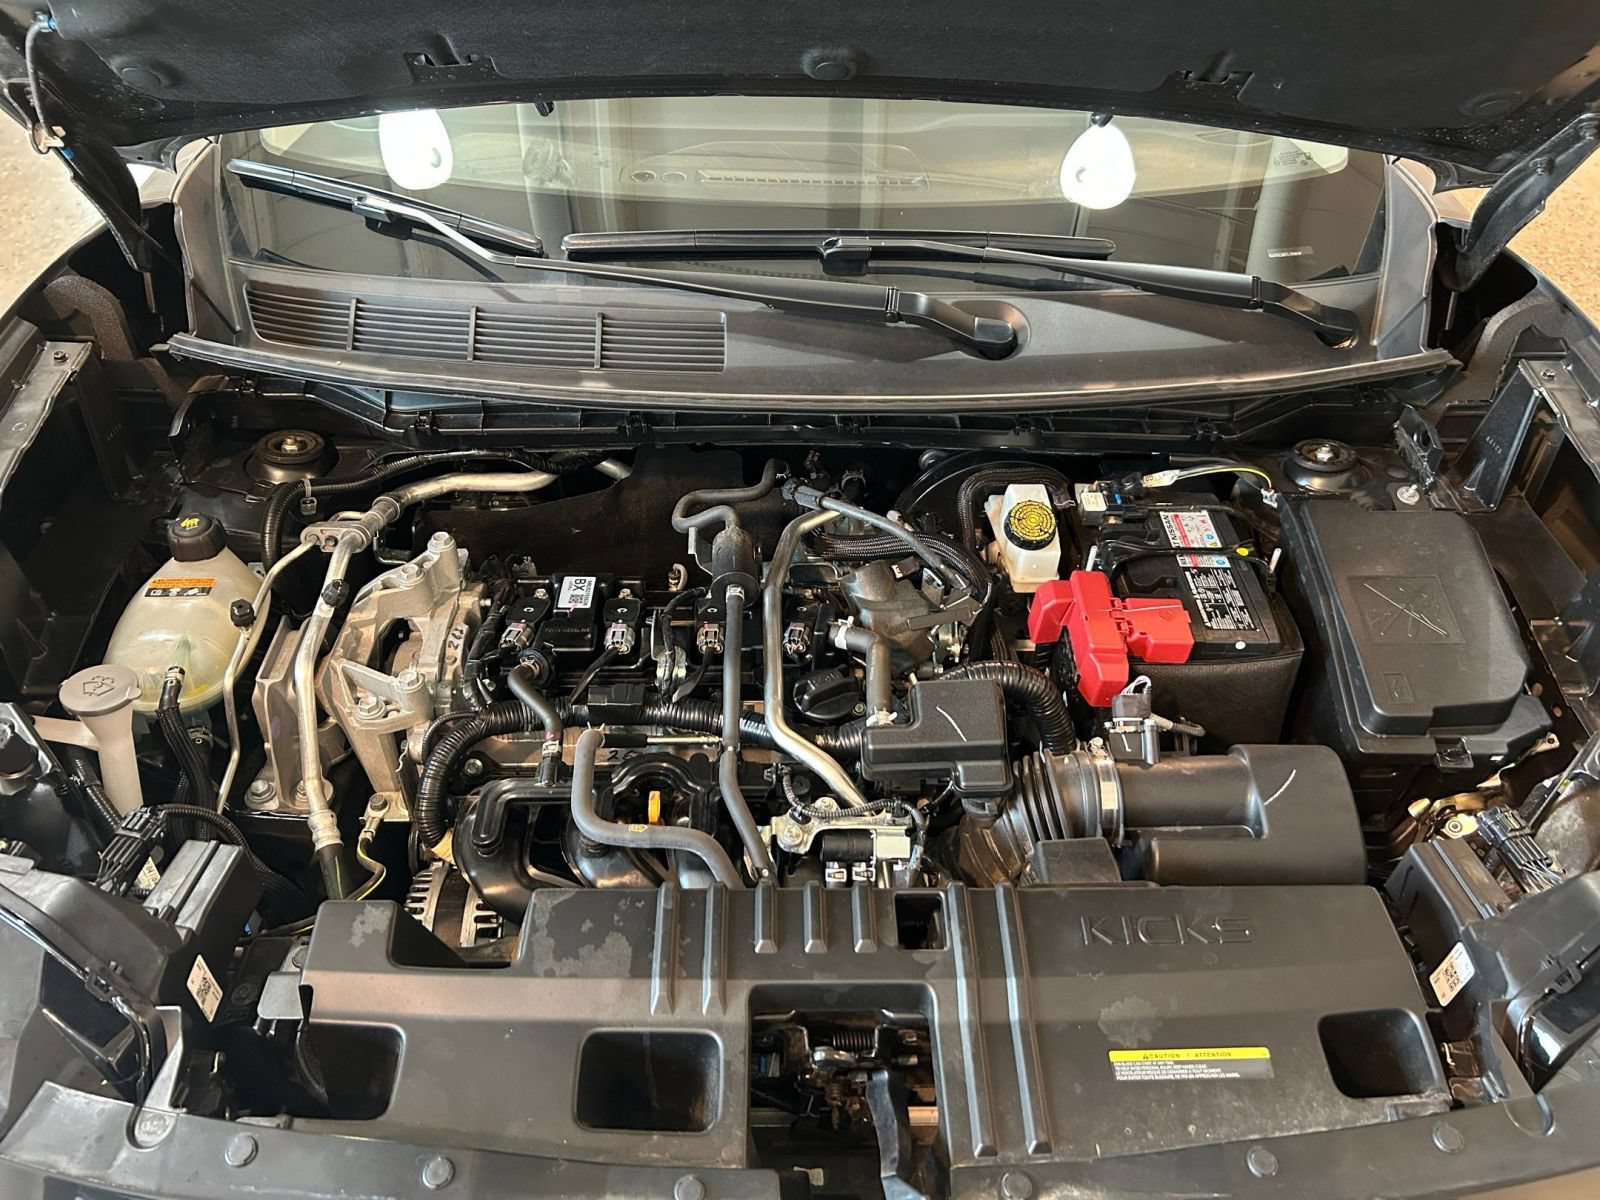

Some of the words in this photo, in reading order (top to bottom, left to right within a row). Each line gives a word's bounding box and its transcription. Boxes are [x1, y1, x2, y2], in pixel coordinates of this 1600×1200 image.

[1163, 514, 1178, 541] NISSAN
[574, 578, 587, 592] BX
[1080, 915, 1255, 945] KICKS
